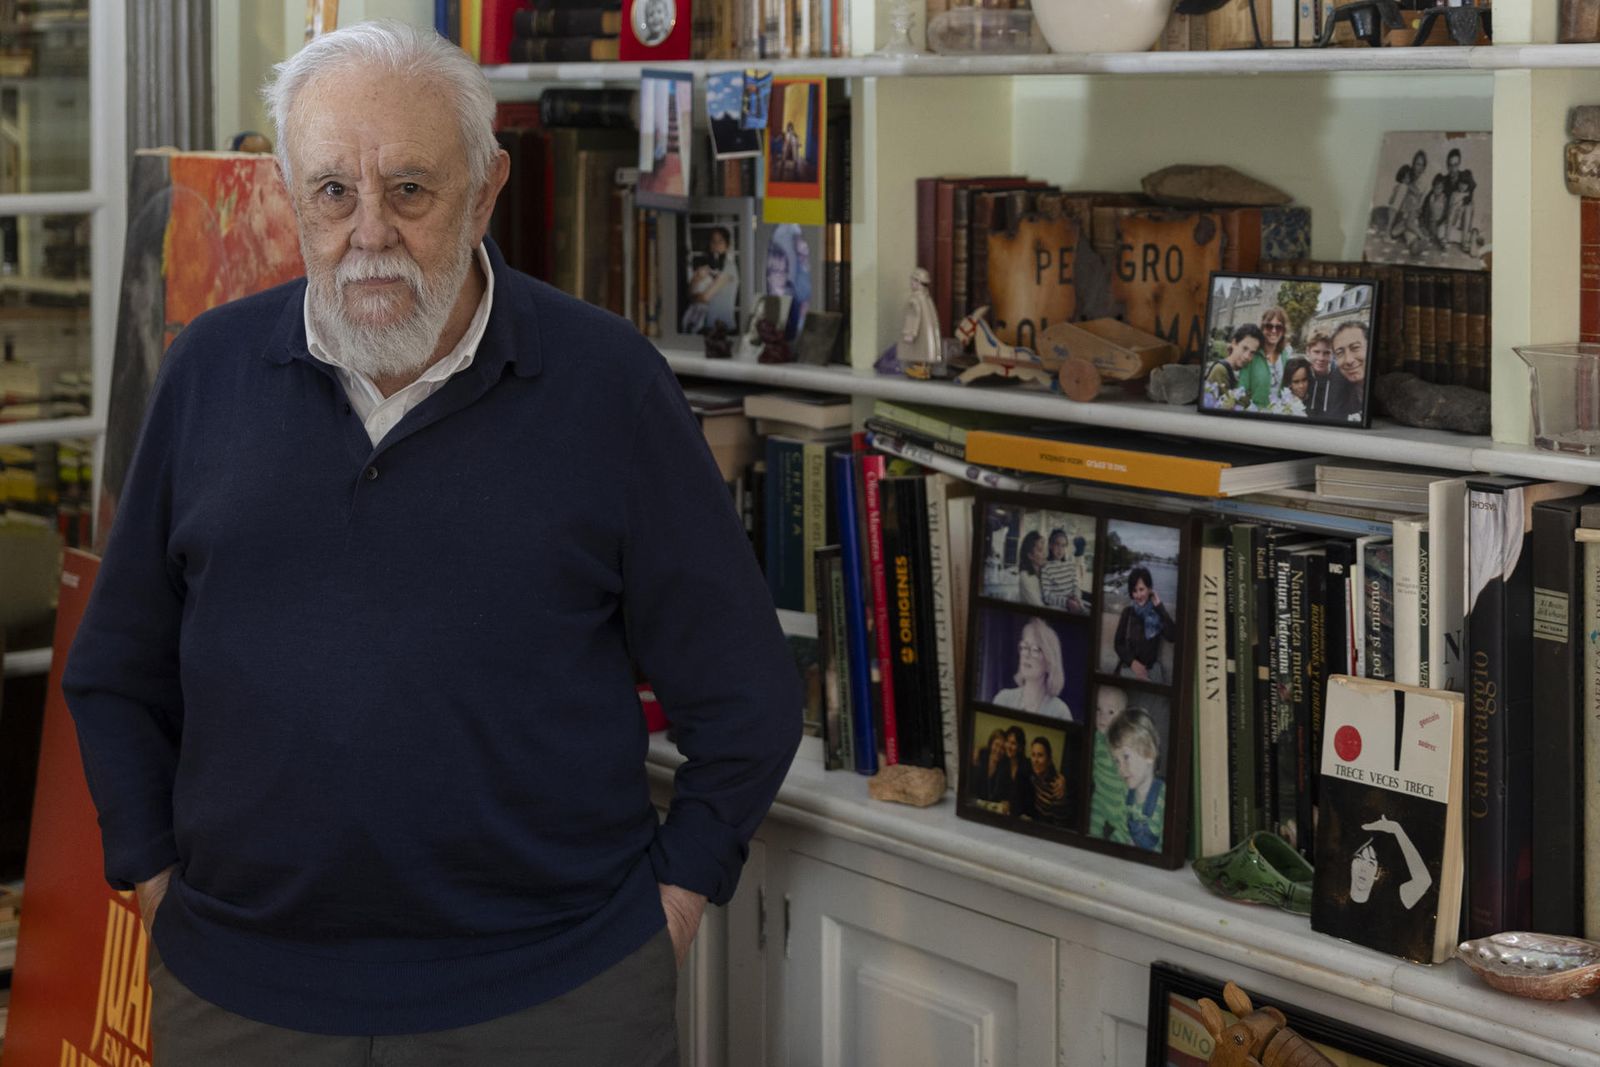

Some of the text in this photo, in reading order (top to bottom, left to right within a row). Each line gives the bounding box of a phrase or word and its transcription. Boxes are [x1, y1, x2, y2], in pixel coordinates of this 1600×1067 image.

[895, 555, 912, 642] ORIGENES
[1257, 546, 1267, 580] Rafael
[1420, 548, 1428, 626] ARCIMBOLDO
[1202, 574, 1221, 703] ZURBARAN
[1277, 561, 1292, 674] Pintura Victoriana
[1291, 570, 1305, 703] Naturaleza muerta
[1311, 603, 1321, 665] BODEGONES
[1370, 580, 1381, 631] mismo
[1372, 651, 1385, 677] por
[1311, 680, 1320, 731] FLOREROS
[1471, 650, 1497, 819] Caravaggio
[1334, 764, 1434, 797] TRECE VECES TRECE
[90, 898, 152, 1053] JUA
